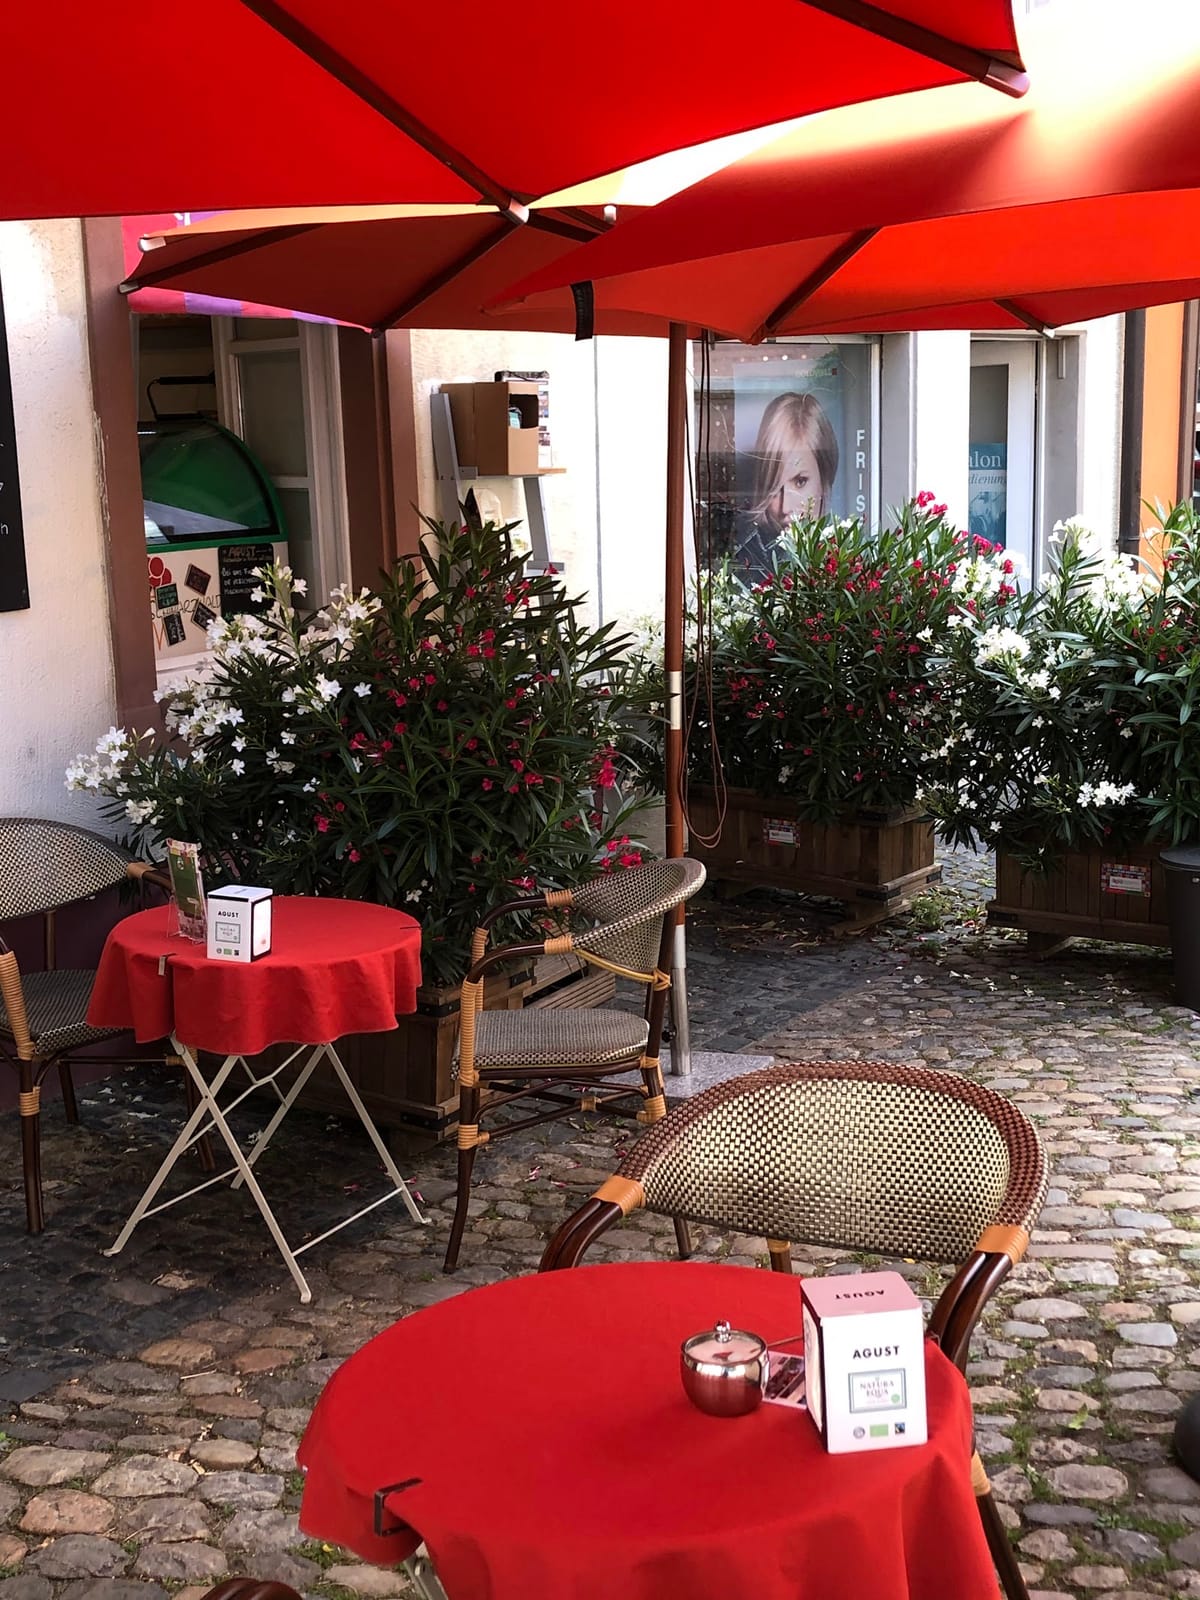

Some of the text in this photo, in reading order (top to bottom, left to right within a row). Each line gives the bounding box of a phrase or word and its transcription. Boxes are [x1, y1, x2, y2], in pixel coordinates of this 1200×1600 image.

[856, 429, 866, 526] FRIS
[217, 910, 240, 918] AGUST
[835, 1289, 885, 1300] AGUST
[853, 1345, 900, 1360] AGUST
